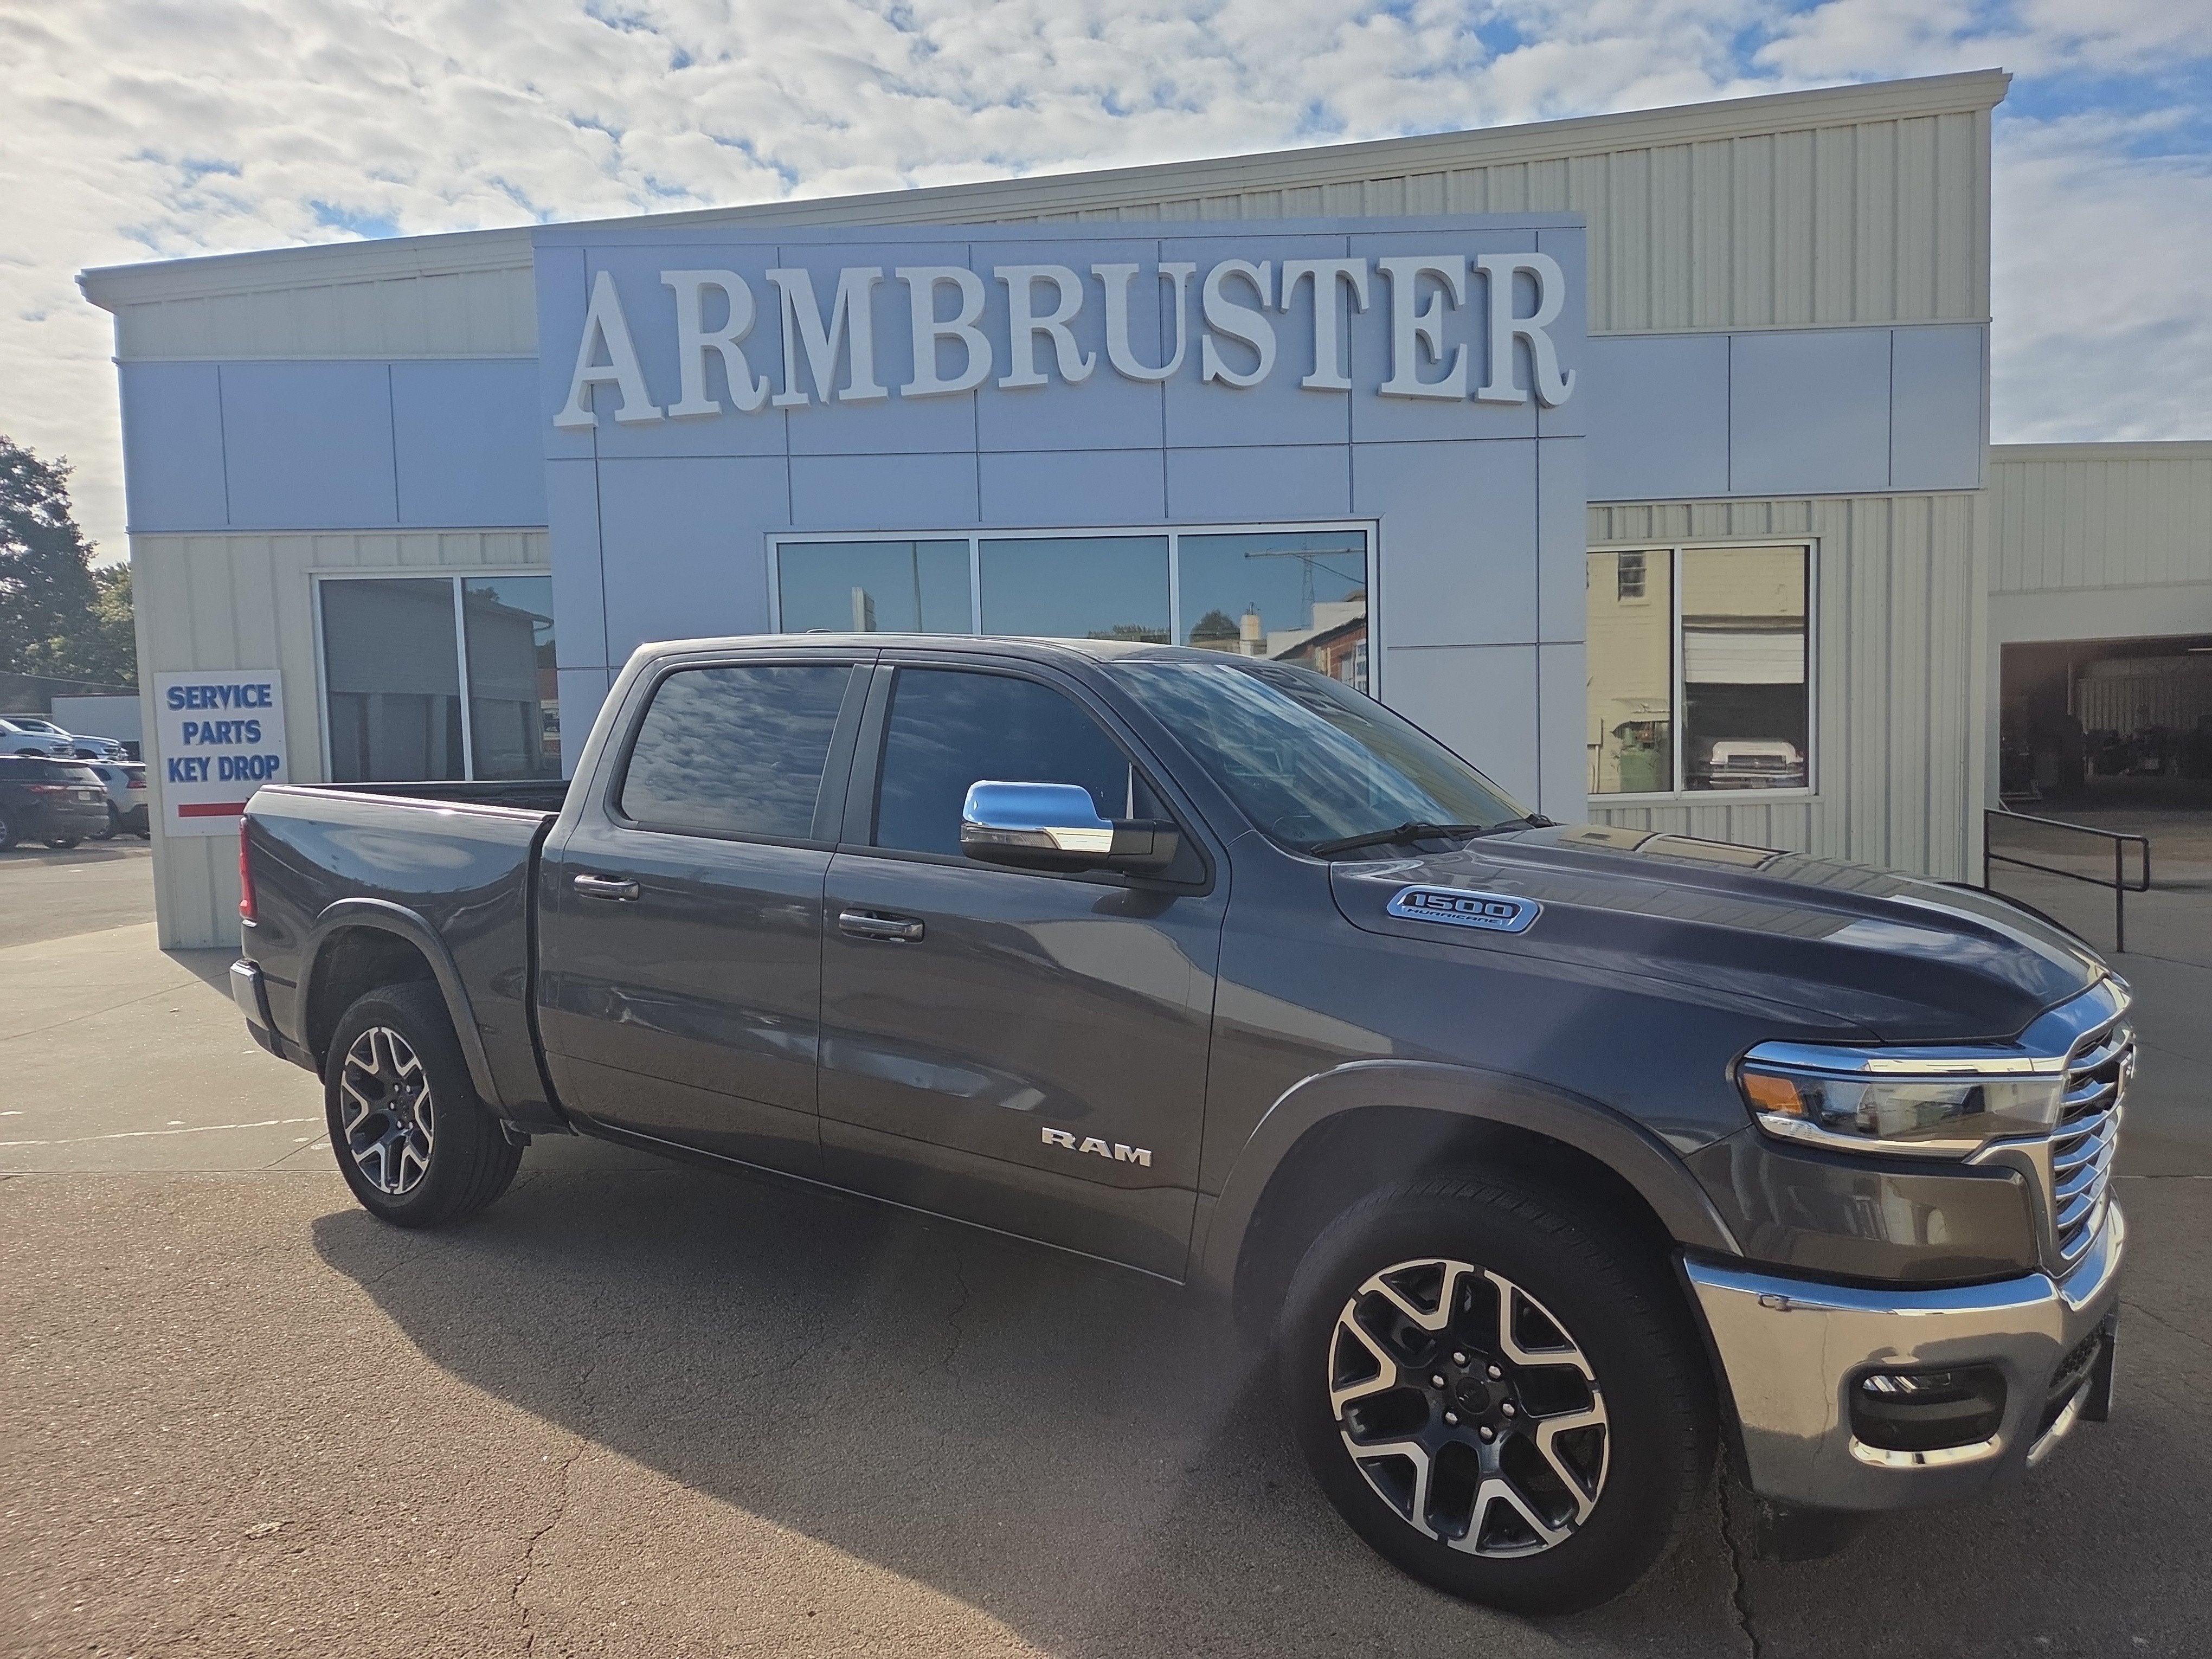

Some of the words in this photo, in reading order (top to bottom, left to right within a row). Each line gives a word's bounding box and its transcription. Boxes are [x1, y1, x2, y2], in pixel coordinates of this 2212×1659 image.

[553, 253, 1576, 427] ARMBRUSTER
[166, 684, 272, 710] SERVICE
[182, 719, 261, 745] PARTS
[167, 756, 211, 782] KEY
[218, 755, 280, 781] DROP
[1407, 909, 1499, 924] HURRICANE
[1413, 894, 1513, 917] 1500
[1041, 1127, 1153, 1167] RAM
